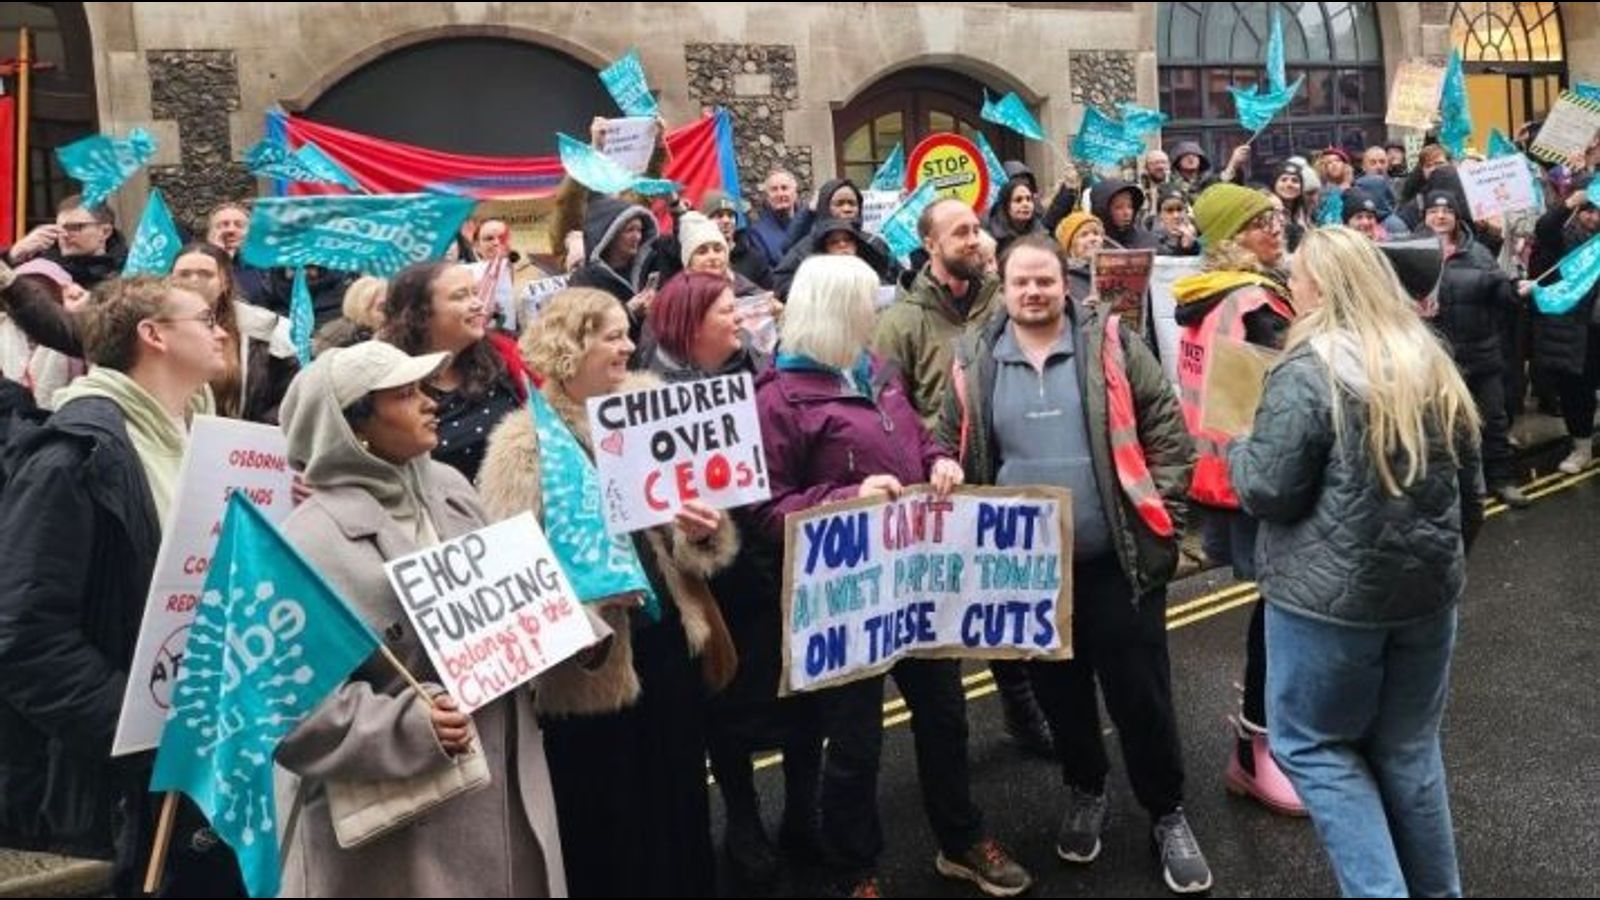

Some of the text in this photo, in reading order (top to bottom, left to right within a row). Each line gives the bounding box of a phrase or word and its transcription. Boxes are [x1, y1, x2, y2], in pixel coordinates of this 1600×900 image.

[923, 155, 969, 176] STOP
[598, 376, 747, 430] CHILDREN
[652, 413, 741, 462] OVER
[392, 533, 486, 611] EHCP
[804, 512, 869, 575] YOU
[415, 557, 561, 650] FUNDING
[825, 564, 883, 617] WET
[894, 553, 965, 599] PAPER
[973, 553, 1060, 591] TOWEL
[441, 596, 573, 679] belongs to the
[805, 599, 1054, 677] ON THESE CUTS
